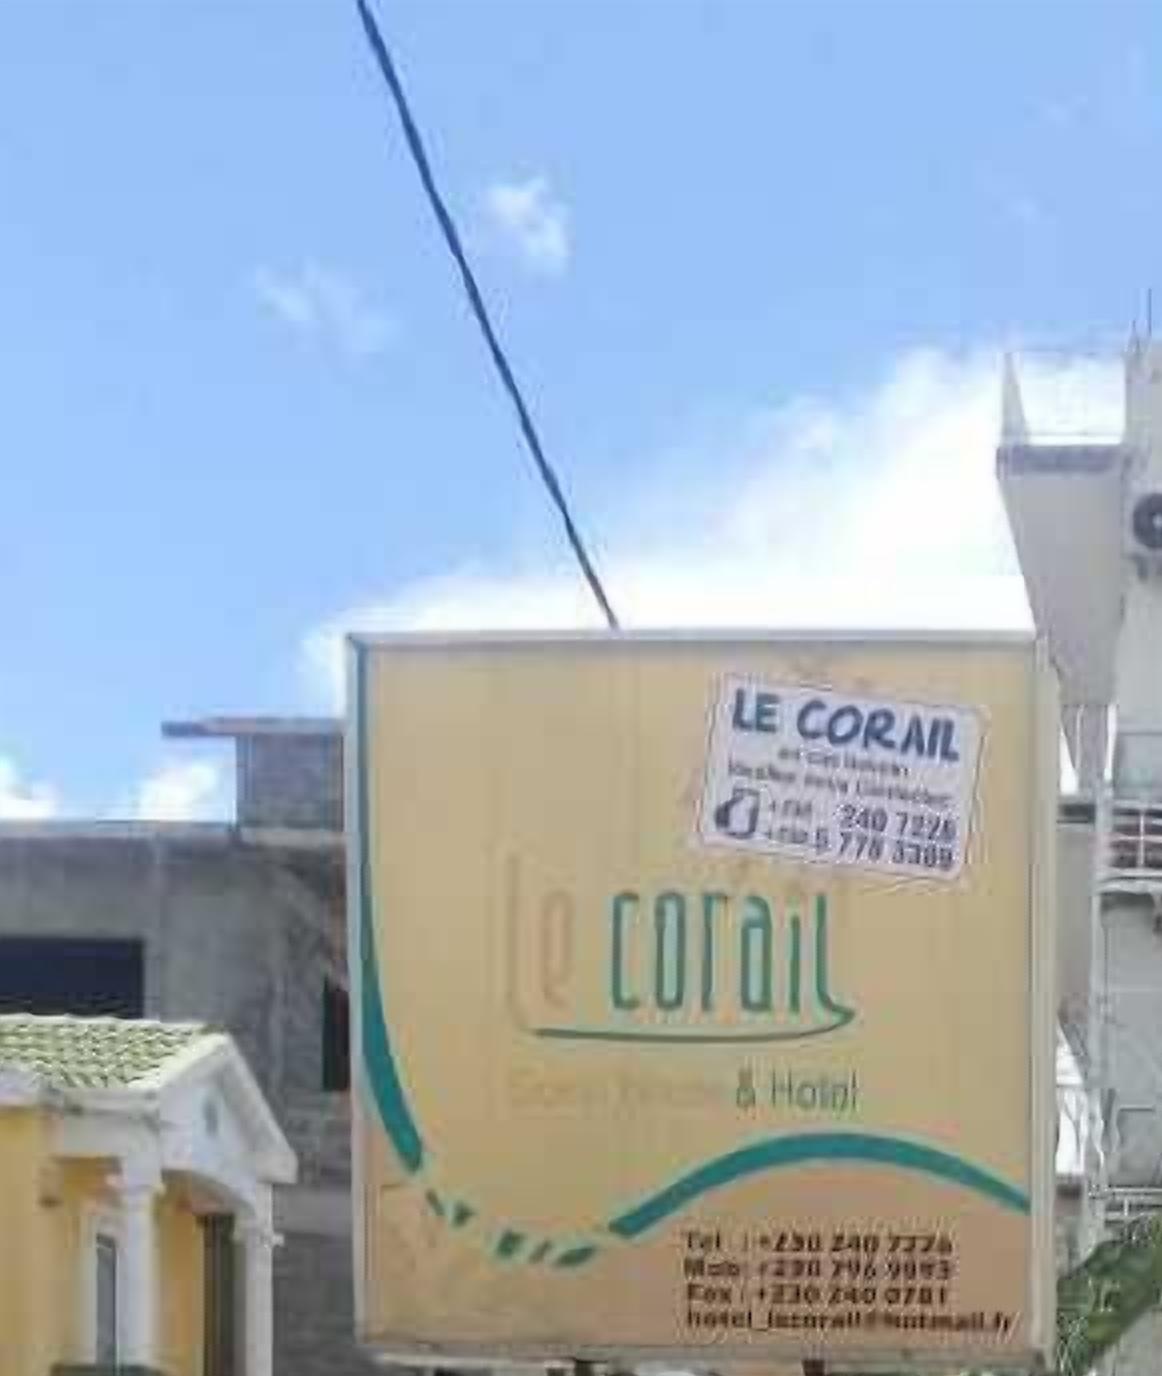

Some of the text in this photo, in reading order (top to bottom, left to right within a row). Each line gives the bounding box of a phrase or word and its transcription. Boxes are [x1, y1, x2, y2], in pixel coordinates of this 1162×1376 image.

[732, 687, 780, 733] LE
[797, 699, 960, 762] CORAIL
[612, 890, 853, 1014] corail
